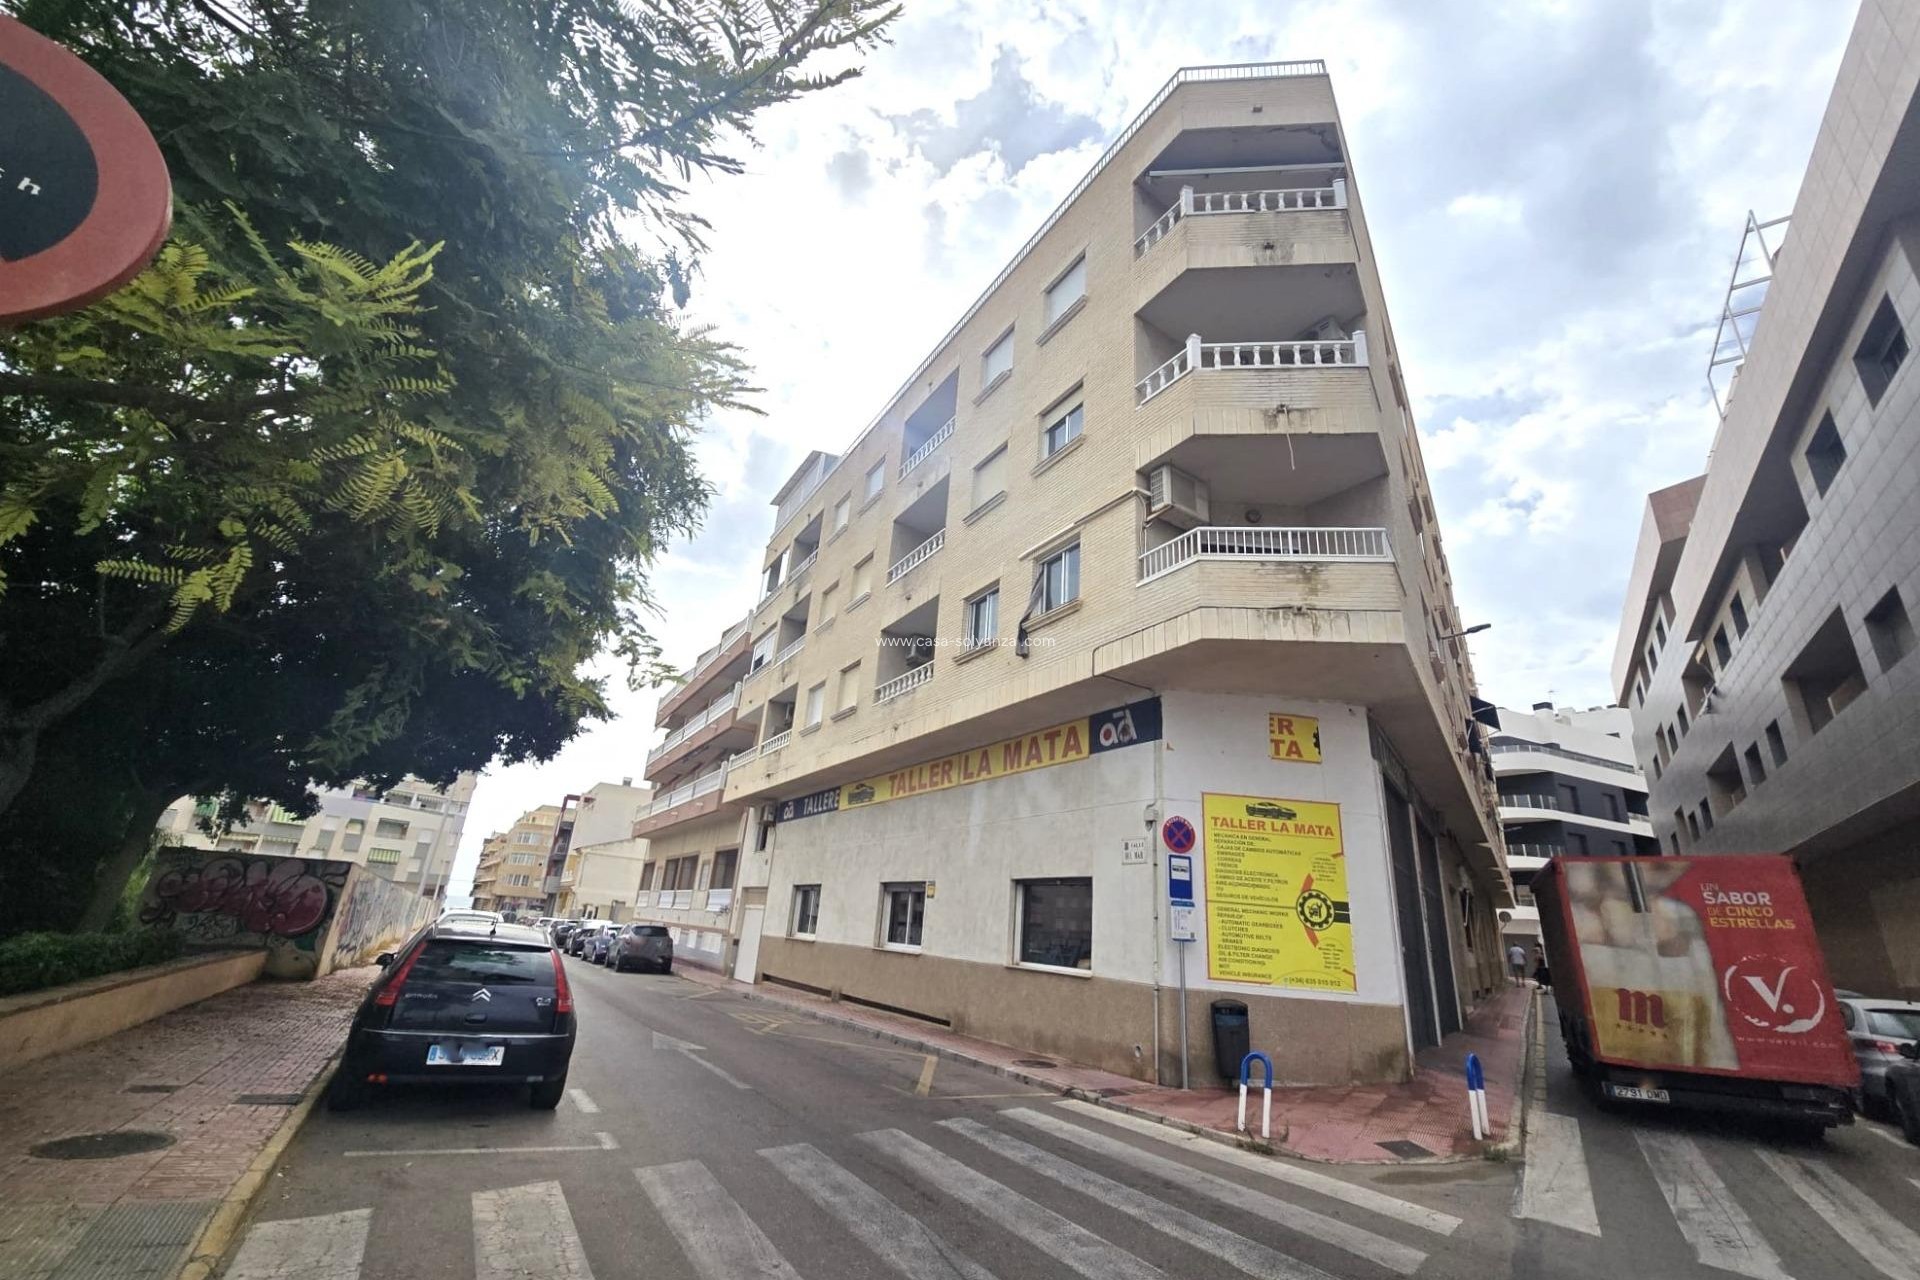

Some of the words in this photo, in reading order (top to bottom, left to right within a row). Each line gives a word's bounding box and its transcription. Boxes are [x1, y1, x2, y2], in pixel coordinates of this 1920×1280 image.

[1270, 739, 1304, 758] TA
[888, 757, 953, 797] TALLER
[962, 750, 992, 780] LA
[1003, 725, 1083, 772] MATA
[1211, 816, 1267, 831] TALLER
[1271, 822, 1290, 833] LA
[1294, 823, 1334, 837] MATA
[1703, 891, 1772, 905] SABOR
[1726, 906, 1774, 917] CINCO
[1709, 917, 1796, 929] ESTRELLAS
